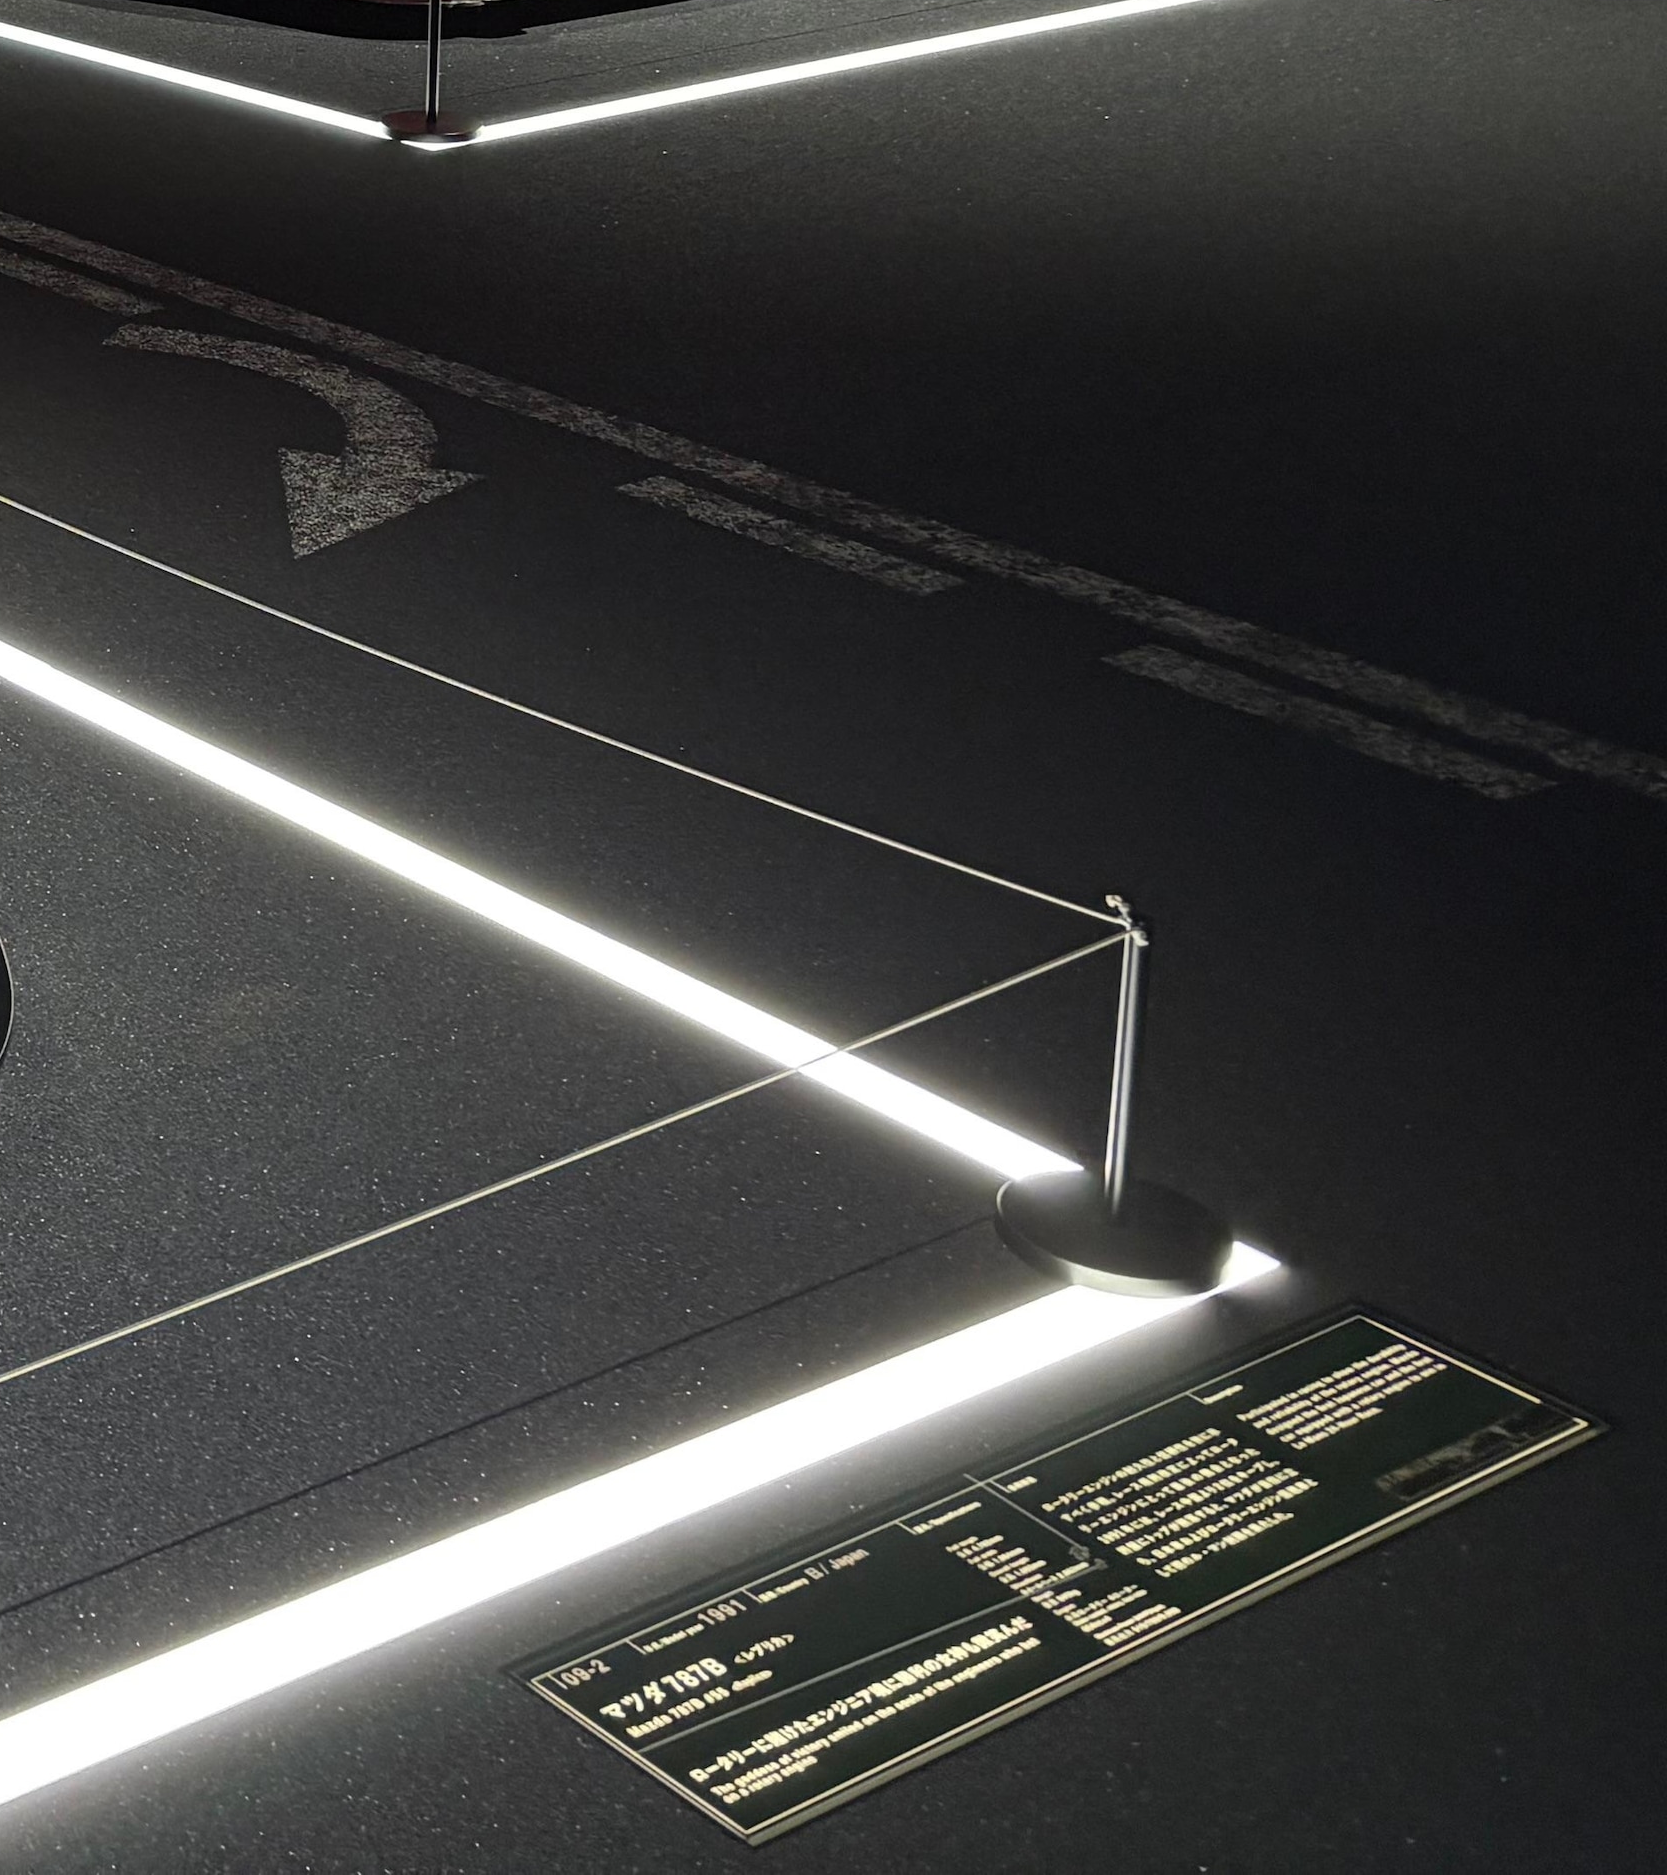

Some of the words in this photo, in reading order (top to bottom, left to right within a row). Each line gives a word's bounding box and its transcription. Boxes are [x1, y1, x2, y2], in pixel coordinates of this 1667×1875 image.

[829, 1549, 869, 1569] Japan
[698, 1600, 746, 1625] 1991
[561, 1660, 611, 1685] 09-2
